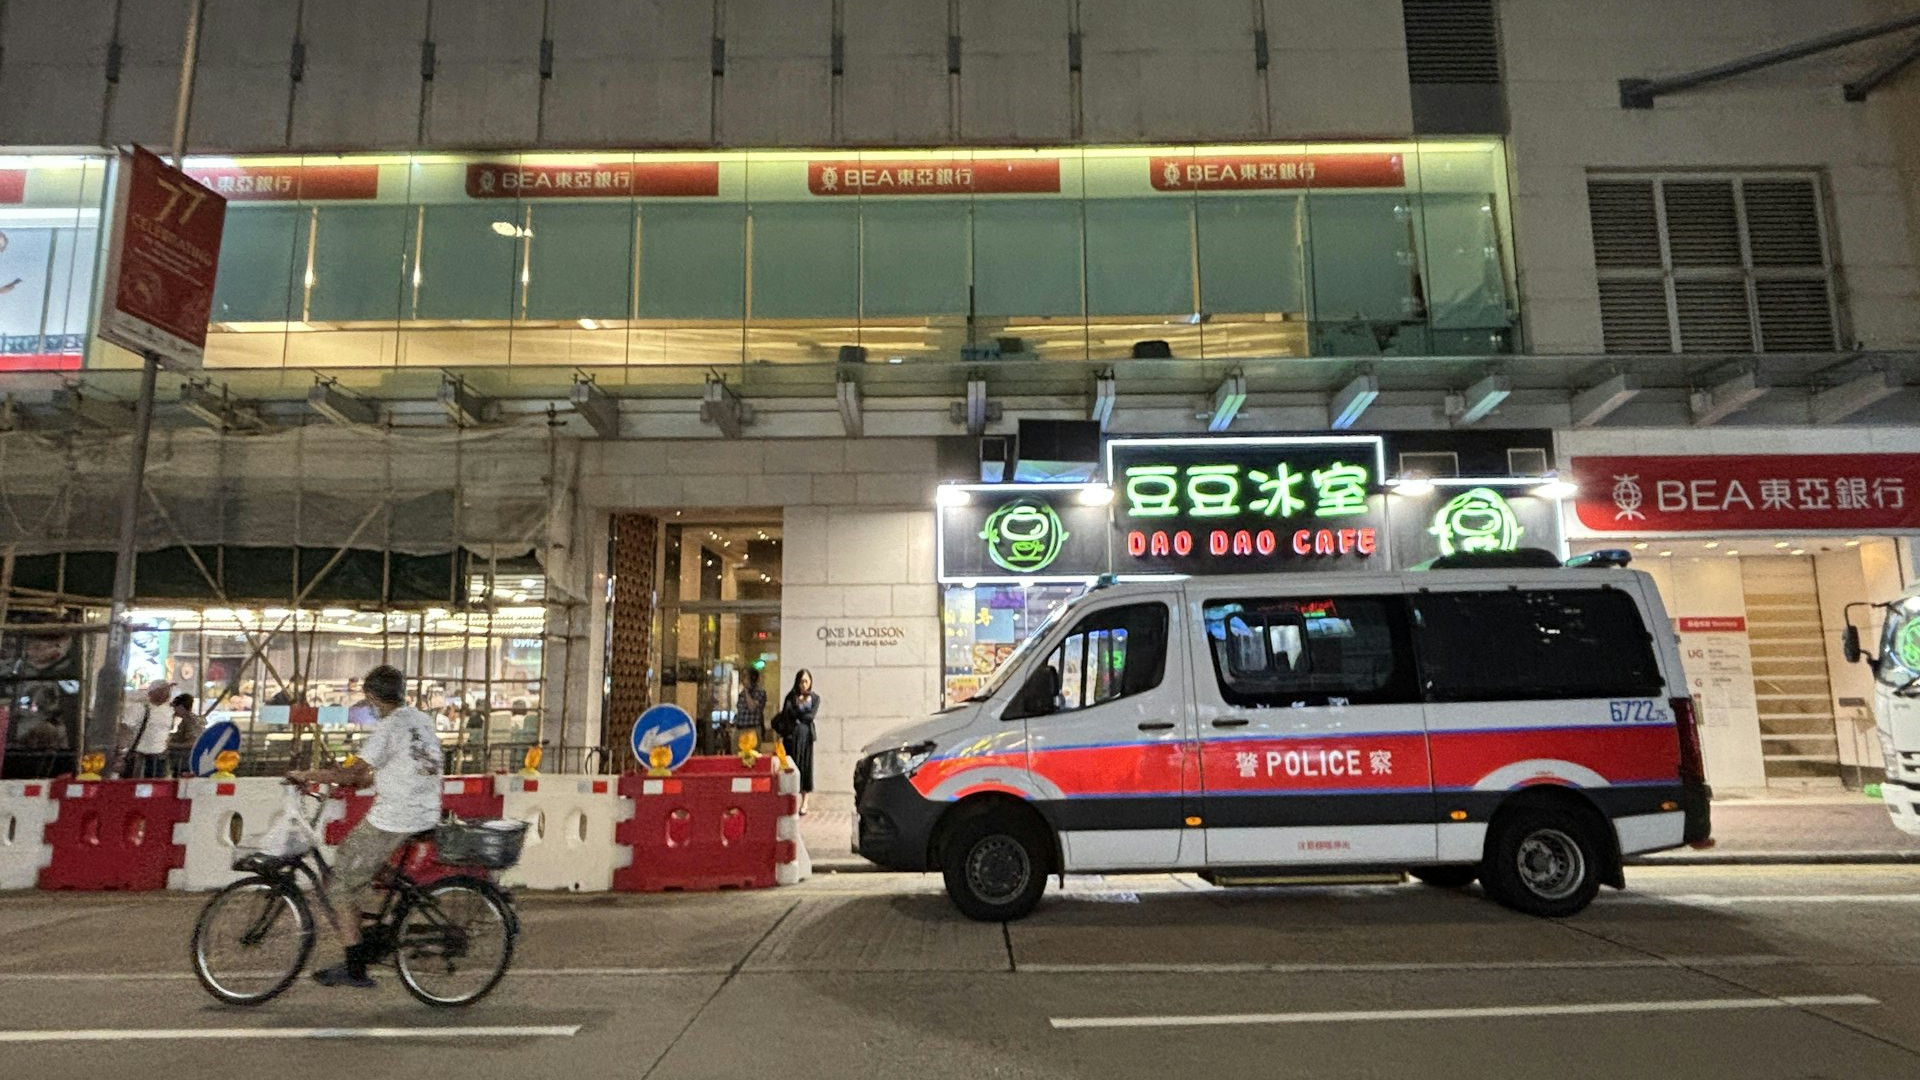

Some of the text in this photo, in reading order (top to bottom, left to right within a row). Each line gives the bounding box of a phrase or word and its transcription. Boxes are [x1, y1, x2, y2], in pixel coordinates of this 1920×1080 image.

[502, 170, 631, 188] BEA 東亞銀行
[844, 167, 972, 186] BEA 東亞銀行
[1186, 162, 1316, 182] BEA 東亞銀行
[156, 175, 208, 225] 77
[1125, 461, 1369, 518] 豆豆冰室
[1656, 476, 1905, 511] BEA 東亞銀行
[1127, 527, 1377, 557] DAO DAO CAFE
[847, 626, 905, 639] MADISON
[1610, 700, 1655, 722] 6722
[1235, 750, 1392, 778] 警 POLICE 察
